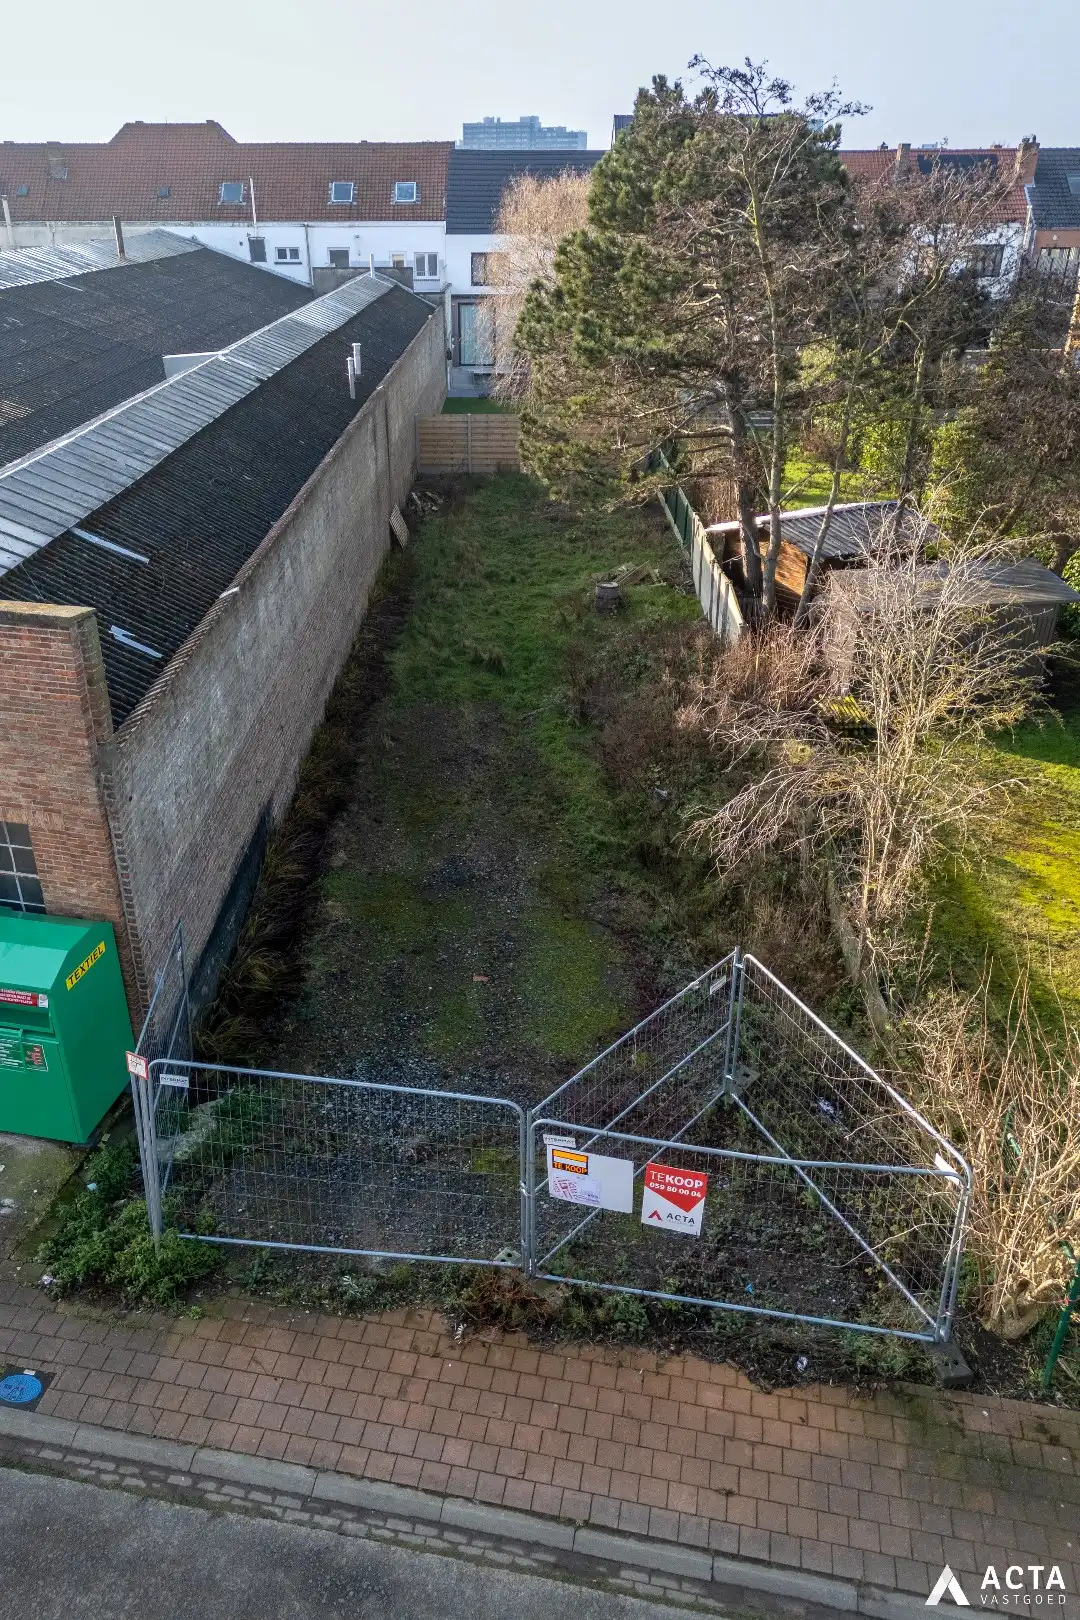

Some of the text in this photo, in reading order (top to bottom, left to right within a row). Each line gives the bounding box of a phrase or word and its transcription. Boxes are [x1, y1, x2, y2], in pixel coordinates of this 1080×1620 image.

[68, 946, 104, 985] TEXTIEL
[553, 1161, 588, 1174] TE KOOP
[649, 1181, 701, 1198] 059 80 00 04
[666, 1212, 695, 1225] ACTA
